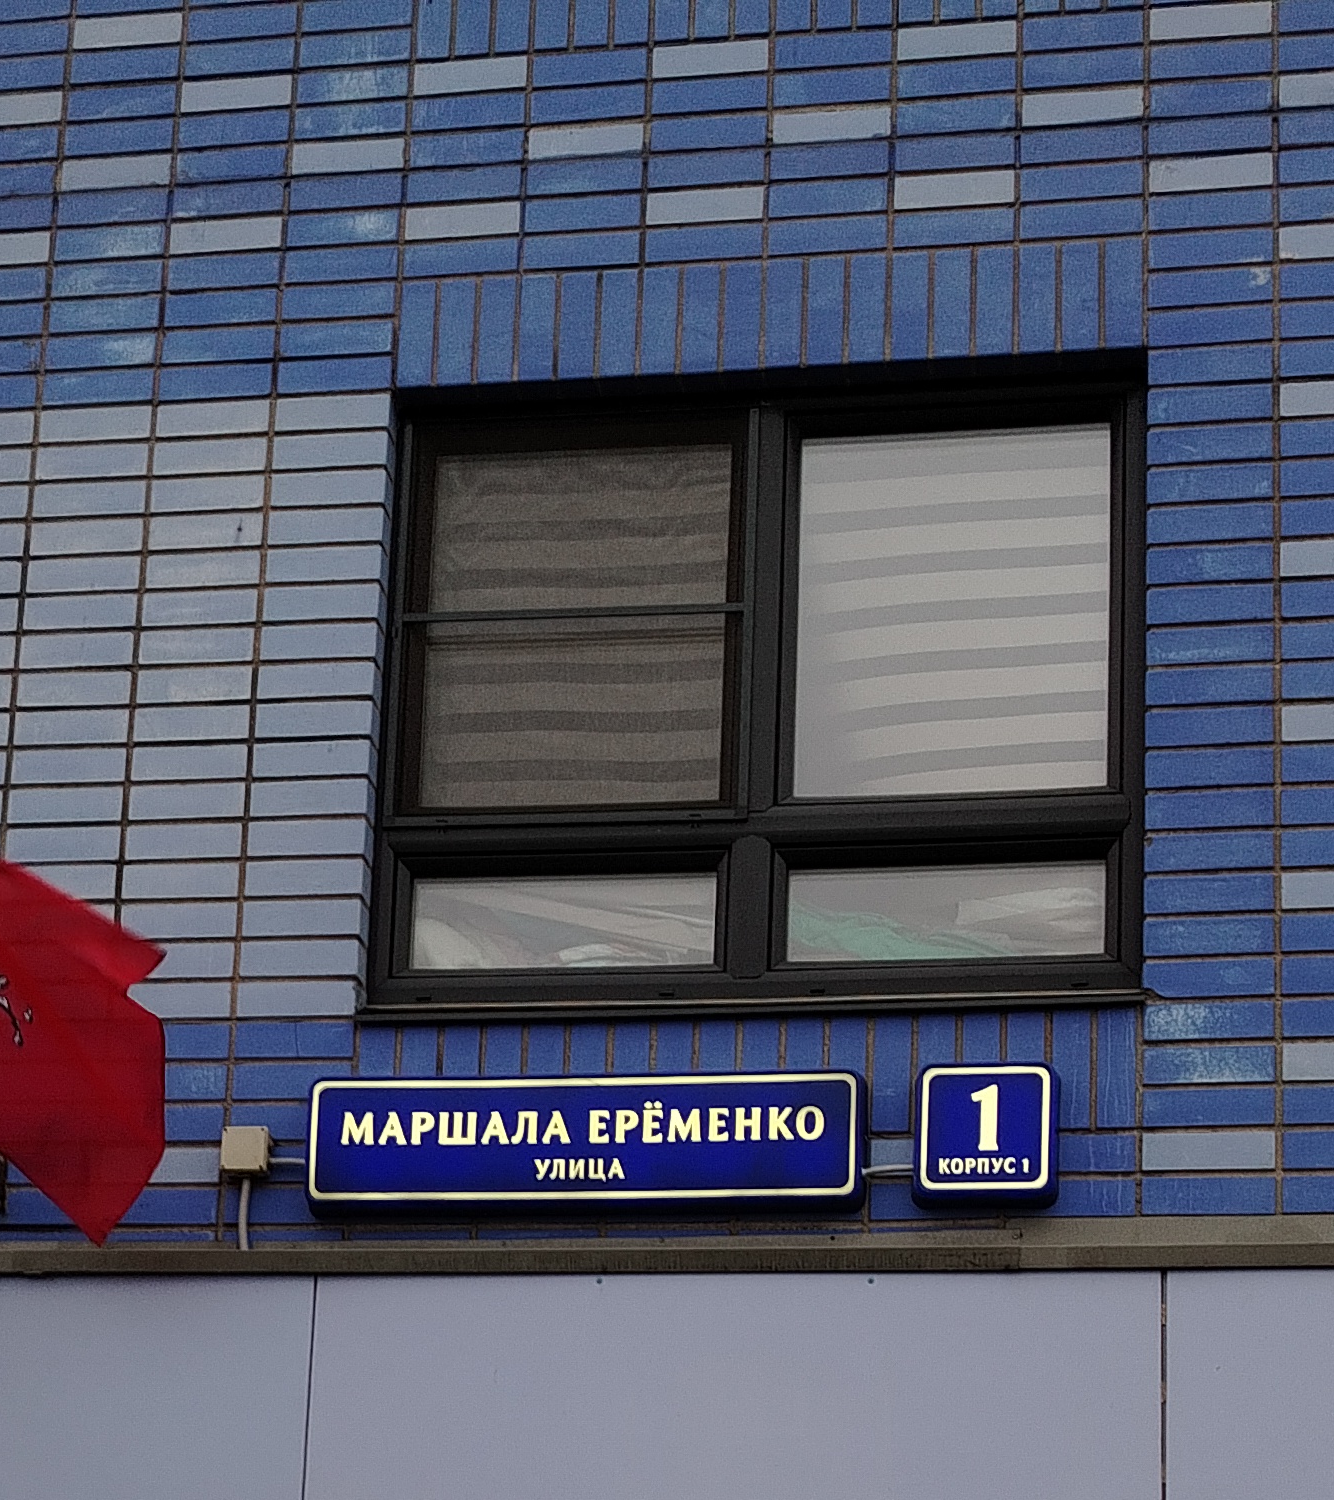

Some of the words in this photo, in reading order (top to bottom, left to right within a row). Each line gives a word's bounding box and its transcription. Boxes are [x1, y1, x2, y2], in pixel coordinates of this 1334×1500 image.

[340, 1110, 571, 1146] МАРШАЛА
[588, 1100, 825, 1144] ЕРЁМЕНКО
[970, 1084, 999, 1152] 1
[533, 1157, 625, 1182] УЛИЦА
[938, 1156, 1016, 1175] КОРПУС
[1021, 1157, 1030, 1174] 1
